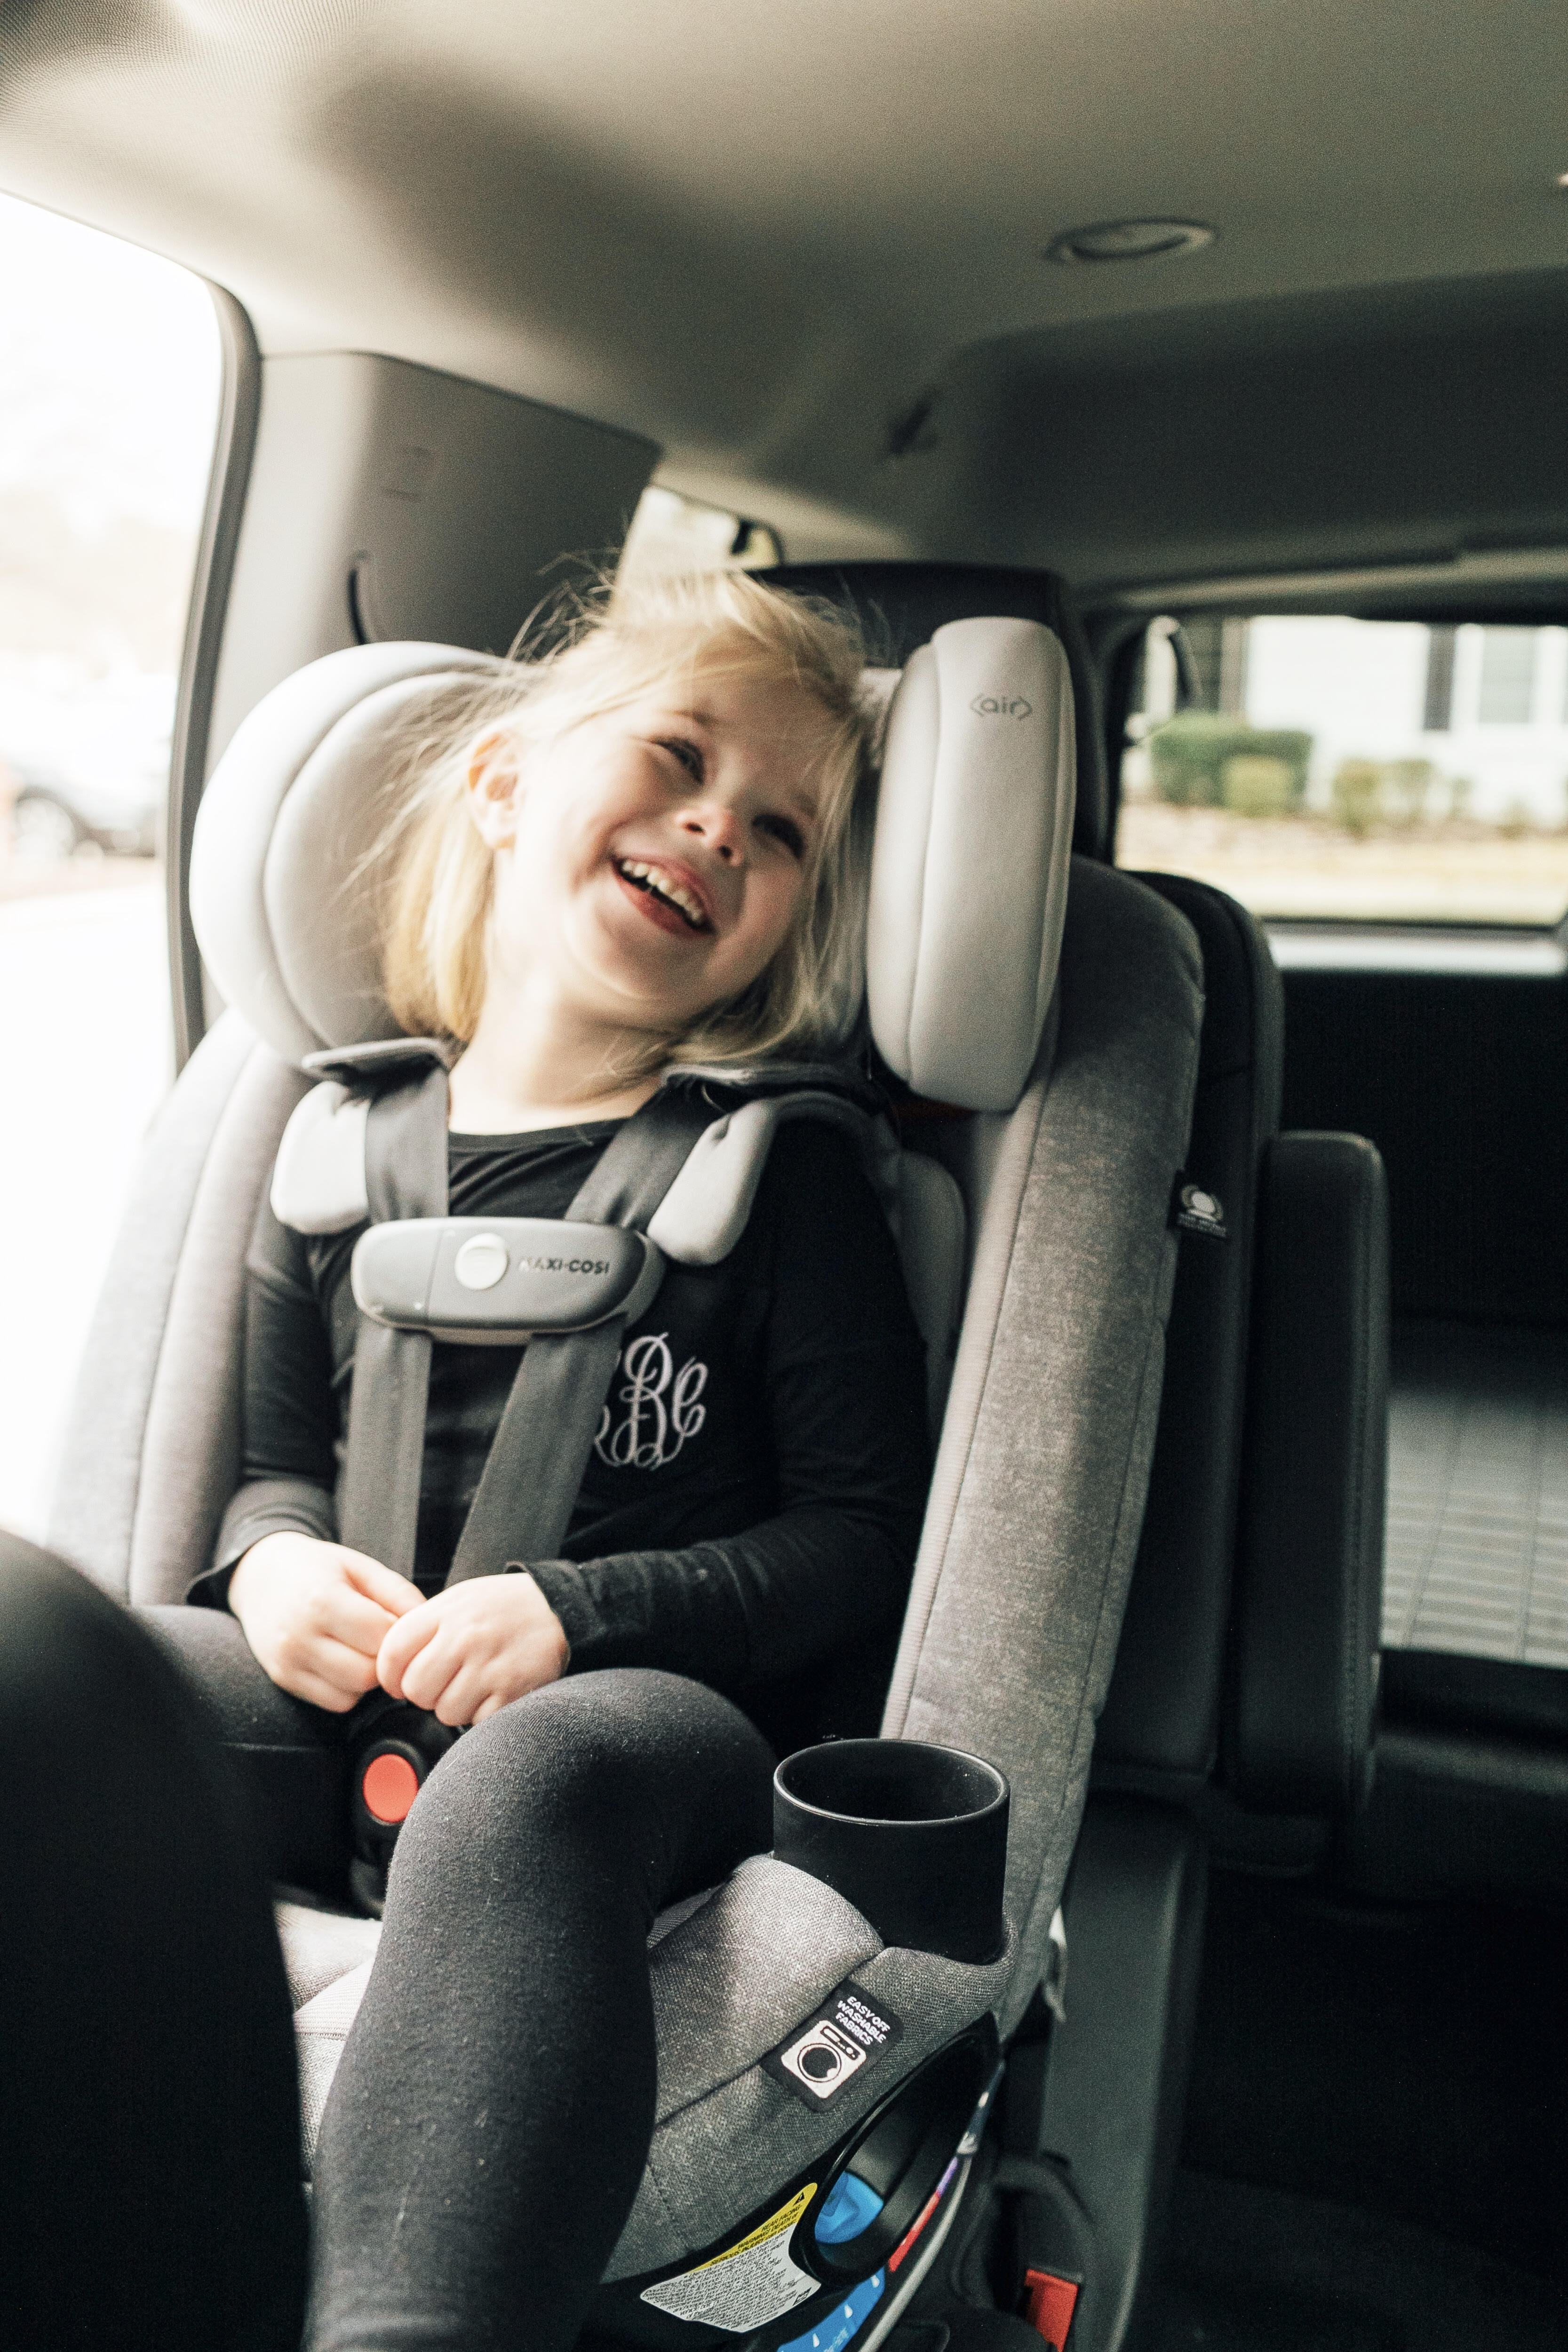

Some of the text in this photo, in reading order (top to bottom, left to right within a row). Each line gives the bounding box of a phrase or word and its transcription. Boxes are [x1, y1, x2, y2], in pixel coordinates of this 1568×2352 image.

[836, 2014, 873, 2045] FABRICS
[837, 2000, 886, 2043] WASHABLE
[847, 1996, 891, 2032] EASY OFF
